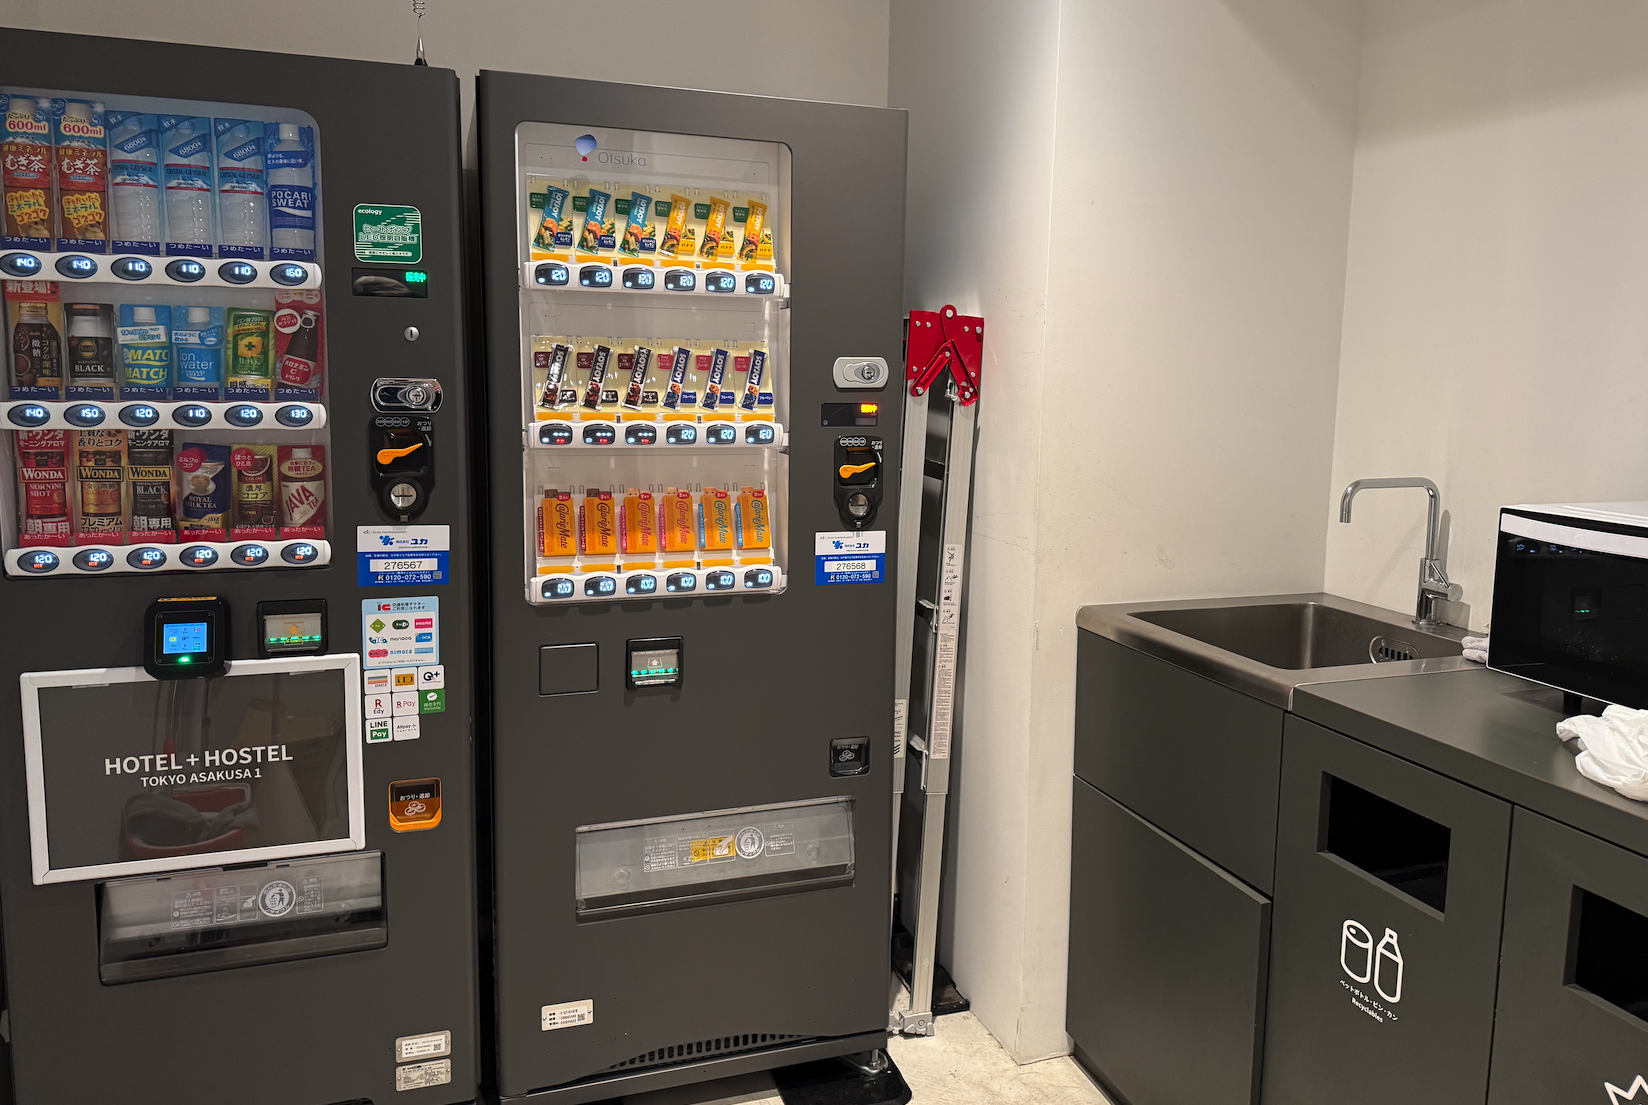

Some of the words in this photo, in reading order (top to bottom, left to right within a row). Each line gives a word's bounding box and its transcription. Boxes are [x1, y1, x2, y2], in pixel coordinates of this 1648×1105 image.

[8, 120, 46, 132] 600ml
[63, 124, 102, 136] 600ml
[5, 154, 46, 172] むぎ茶
[598, 152, 646, 166] Otsuka
[61, 158, 102, 176] むぎ茶
[130, 164, 152, 172] GEYSER
[184, 168, 206, 176] GEYSER
[238, 172, 260, 180] GEYSER
[272, 190, 312, 200] POCARI
[9, 200, 42, 213] ミネラル
[272, 198, 308, 208] SWEAT
[552, 192, 564, 218] SOYJOY
[66, 202, 98, 216] ミネラル
[595, 196, 606, 221] SOYJOY
[637, 198, 647, 224] SOYJOY
[676, 201, 687, 226] SOYJOY
[16, 209, 48, 224] ゴクゴク
[72, 212, 103, 226] ゴクゴク
[715, 204, 725, 228] SOYJOY
[754, 207, 763, 231] SOYJOY
[16, 258, 35, 268] 140
[72, 260, 90, 270] 140
[128, 262, 146, 272] 110
[182, 264, 199, 274] 110
[234, 266, 252, 276] 110
[286, 268, 302, 277] 160
[180, 361, 214, 369] water
[284, 360, 310, 372] オロナミン
[593, 352, 606, 382] SOYJOY
[634, 353, 647, 384] SOYJOY
[674, 353, 687, 383] SOYJOY
[713, 354, 724, 384] SOYJOY
[124, 368, 168, 379] MATCH
[751, 356, 762, 385] SOYJOY
[26, 408, 44, 417] 140
[81, 408, 98, 417] 150
[135, 409, 152, 417] 120
[189, 409, 205, 417] 110
[240, 409, 257, 418] 120
[291, 409, 307, 418] 130
[681, 430, 695, 439] 120
[721, 430, 734, 439] 120
[760, 429, 772, 439] 120
[78, 438, 122, 447] 香りとコク
[137, 486, 166, 494] BLACK
[286, 485, 314, 521] JAVA
[307, 496, 319, 510] TEA
[81, 517, 123, 526] プレミアム
[133, 516, 172, 530] 朝専用
[26, 520, 70, 534] 朝専用
[143, 551, 160, 560] 120
[195, 550, 212, 558] 120
[246, 548, 262, 556] 120
[296, 547, 312, 555] 120
[34, 554, 52, 563] 120
[90, 553, 107, 562] 120
[384, 561, 422, 570] 276567
[681, 578, 694, 587] 100
[720, 575, 732, 585] 100
[758, 574, 770, 583] 100
[375, 700, 382, 708] R
[105, 753, 183, 775] HOTEL
[186, 754, 199, 766] +
[204, 744, 294, 767] HOSTEL
[141, 774, 186, 788] TOKYO
[190, 768, 252, 783] ASAKUSA
[254, 768, 262, 778] 1
[1352, 997, 1383, 1023] Recyclables
